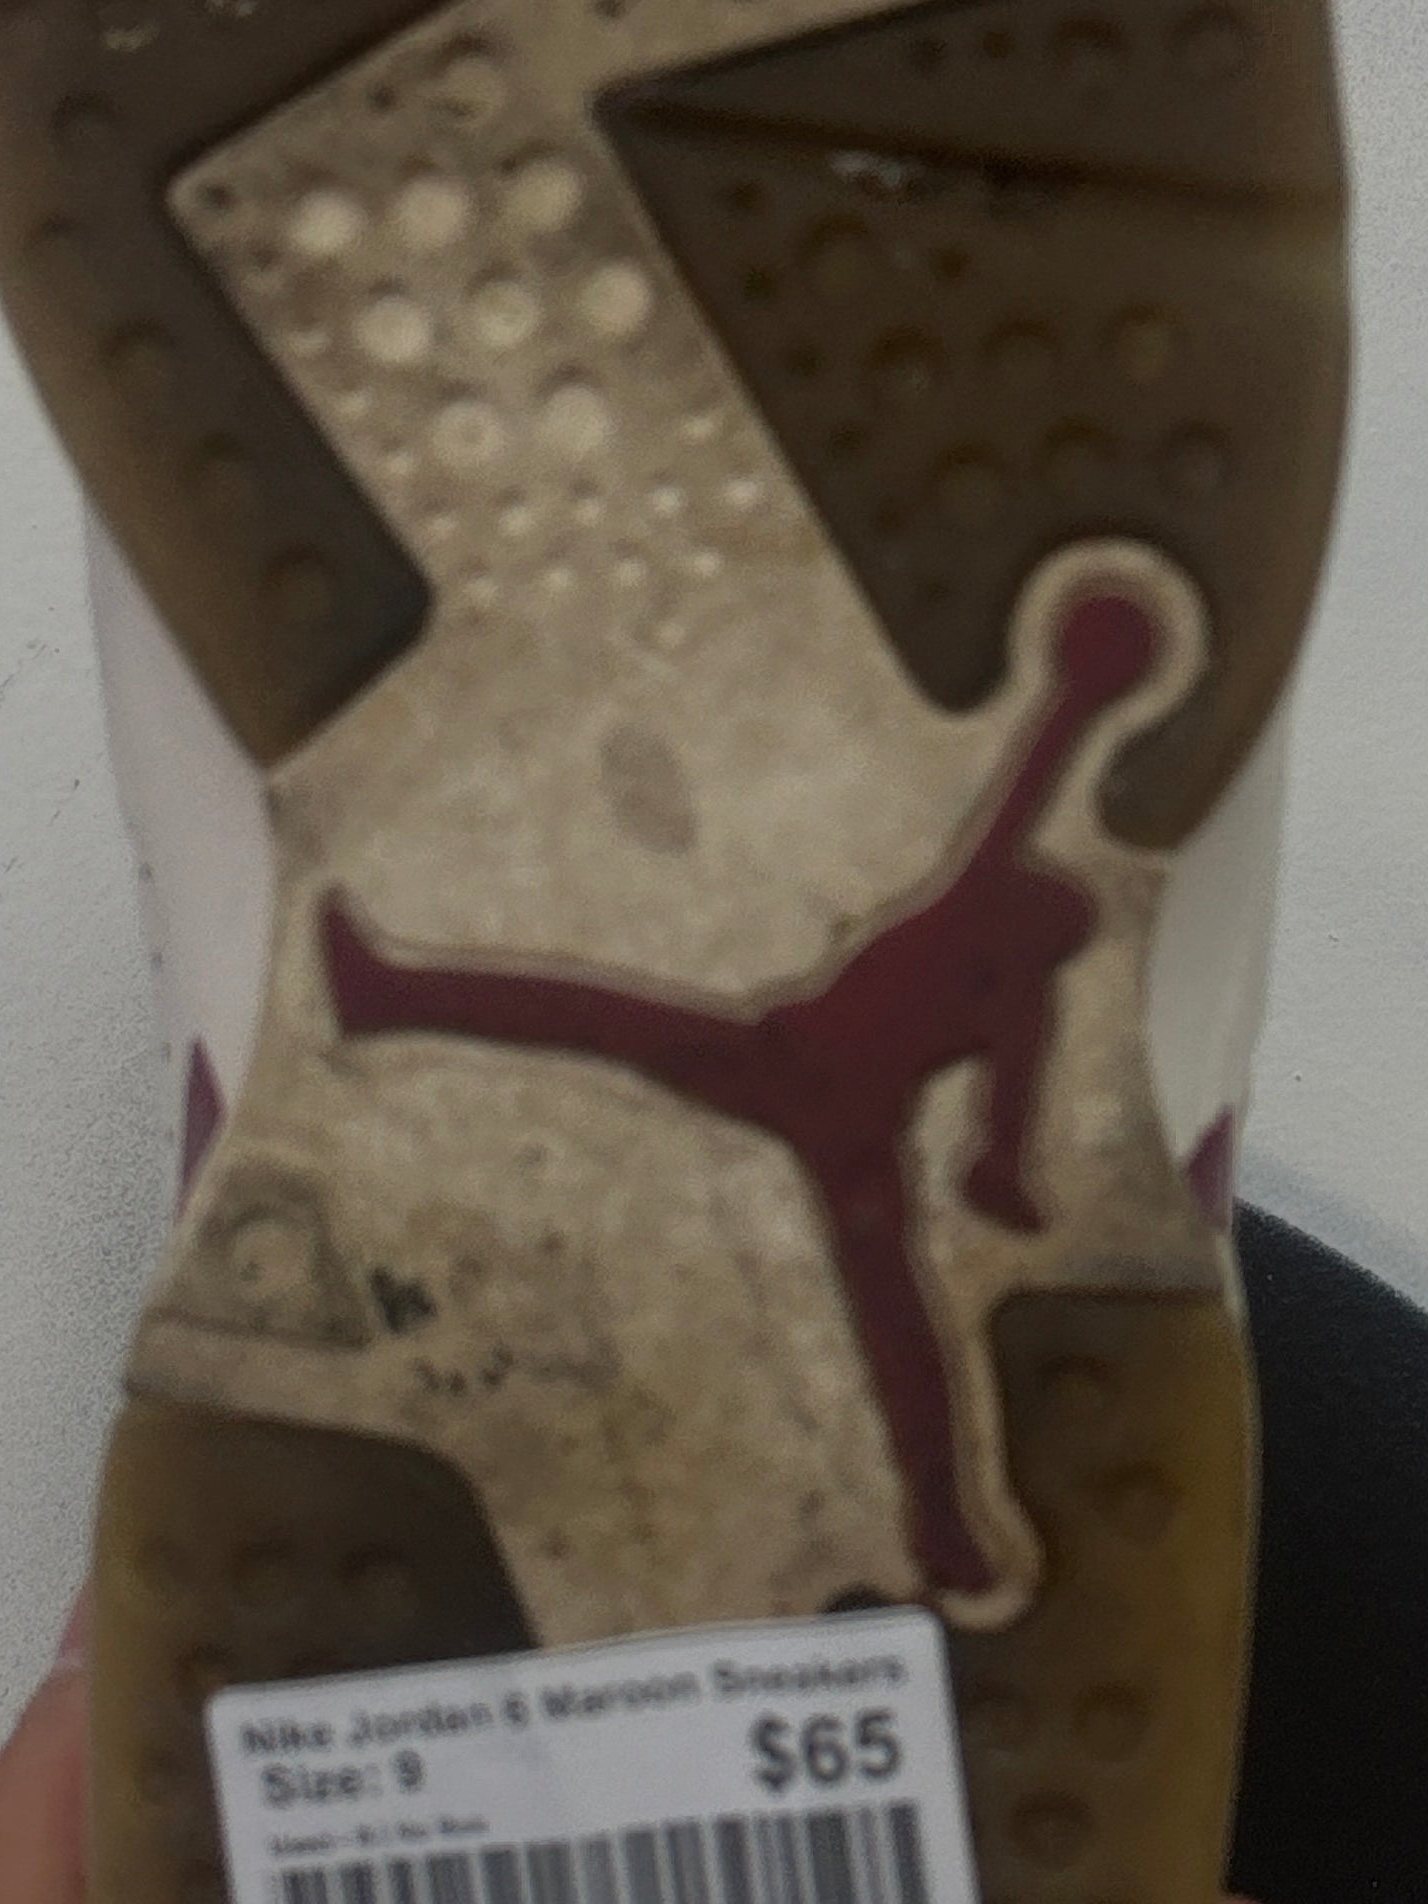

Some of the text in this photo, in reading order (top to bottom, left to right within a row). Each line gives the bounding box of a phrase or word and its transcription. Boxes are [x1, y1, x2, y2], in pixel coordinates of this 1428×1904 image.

[241, 1716, 333, 1756] Nike
[348, 1700, 492, 1747] Jordan
[540, 1670, 700, 1720] Maroon
[711, 1655, 908, 1700] Sneakers
[261, 1748, 425, 1809] Size: 9
[748, 1706, 903, 1795] $65
